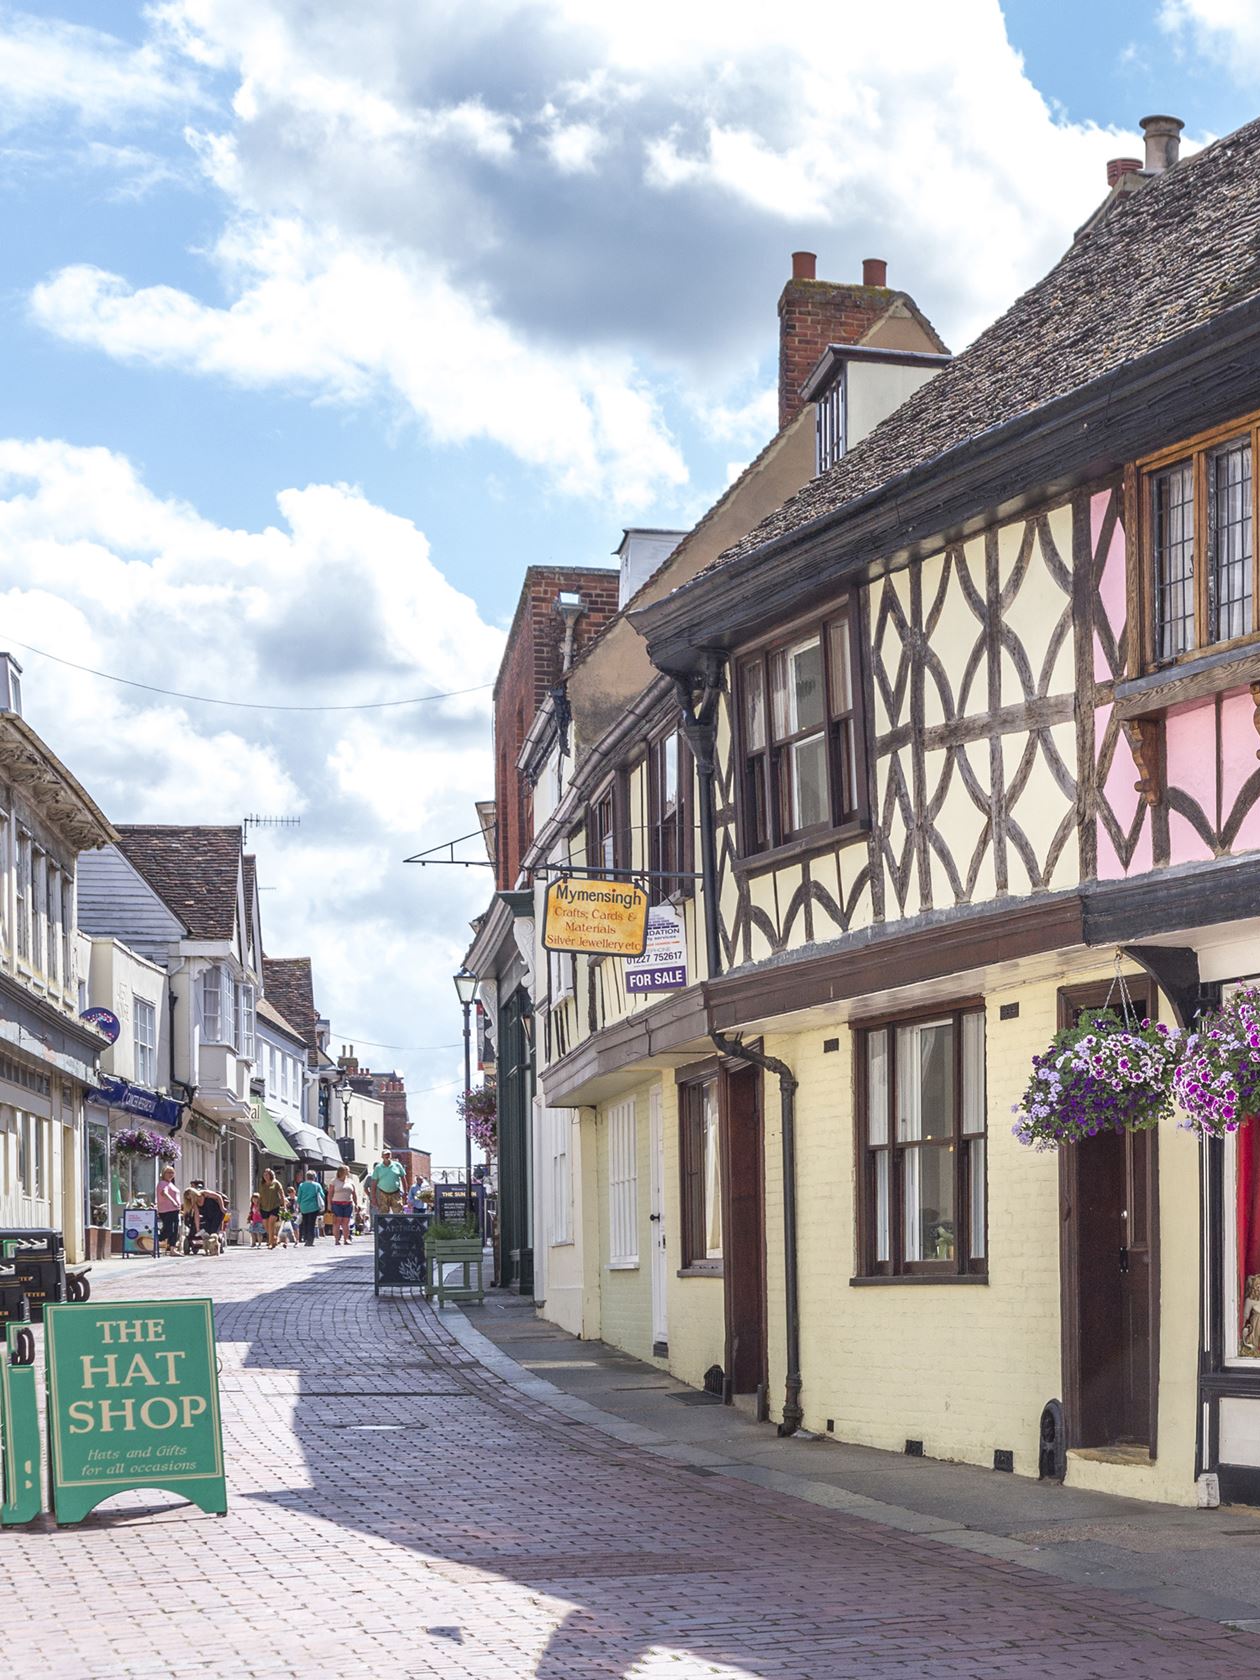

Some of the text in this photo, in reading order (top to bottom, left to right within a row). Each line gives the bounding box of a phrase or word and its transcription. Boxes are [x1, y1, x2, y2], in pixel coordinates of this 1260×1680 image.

[556, 884, 641, 909] Mymensingh
[592, 908, 624, 921] Cards
[627, 911, 637, 922] &
[565, 922, 617, 935] Materials
[648, 928, 680, 937] DATION
[547, 934, 576, 946] Silver
[579, 937, 624, 951] Jewellery
[624, 941, 641, 951] etc
[626, 954, 651, 965] 01227
[653, 951, 682, 962] 752617
[630, 970, 683, 988] FOR SALE
[251, 1104, 260, 1120] al
[96, 1319, 166, 1344] THE
[80, 1351, 186, 1389] HAT
[68, 1395, 207, 1434] SHOP
[87, 1445, 188, 1461] Hats and Gifts
[81, 1460, 197, 1476] for all occasions
